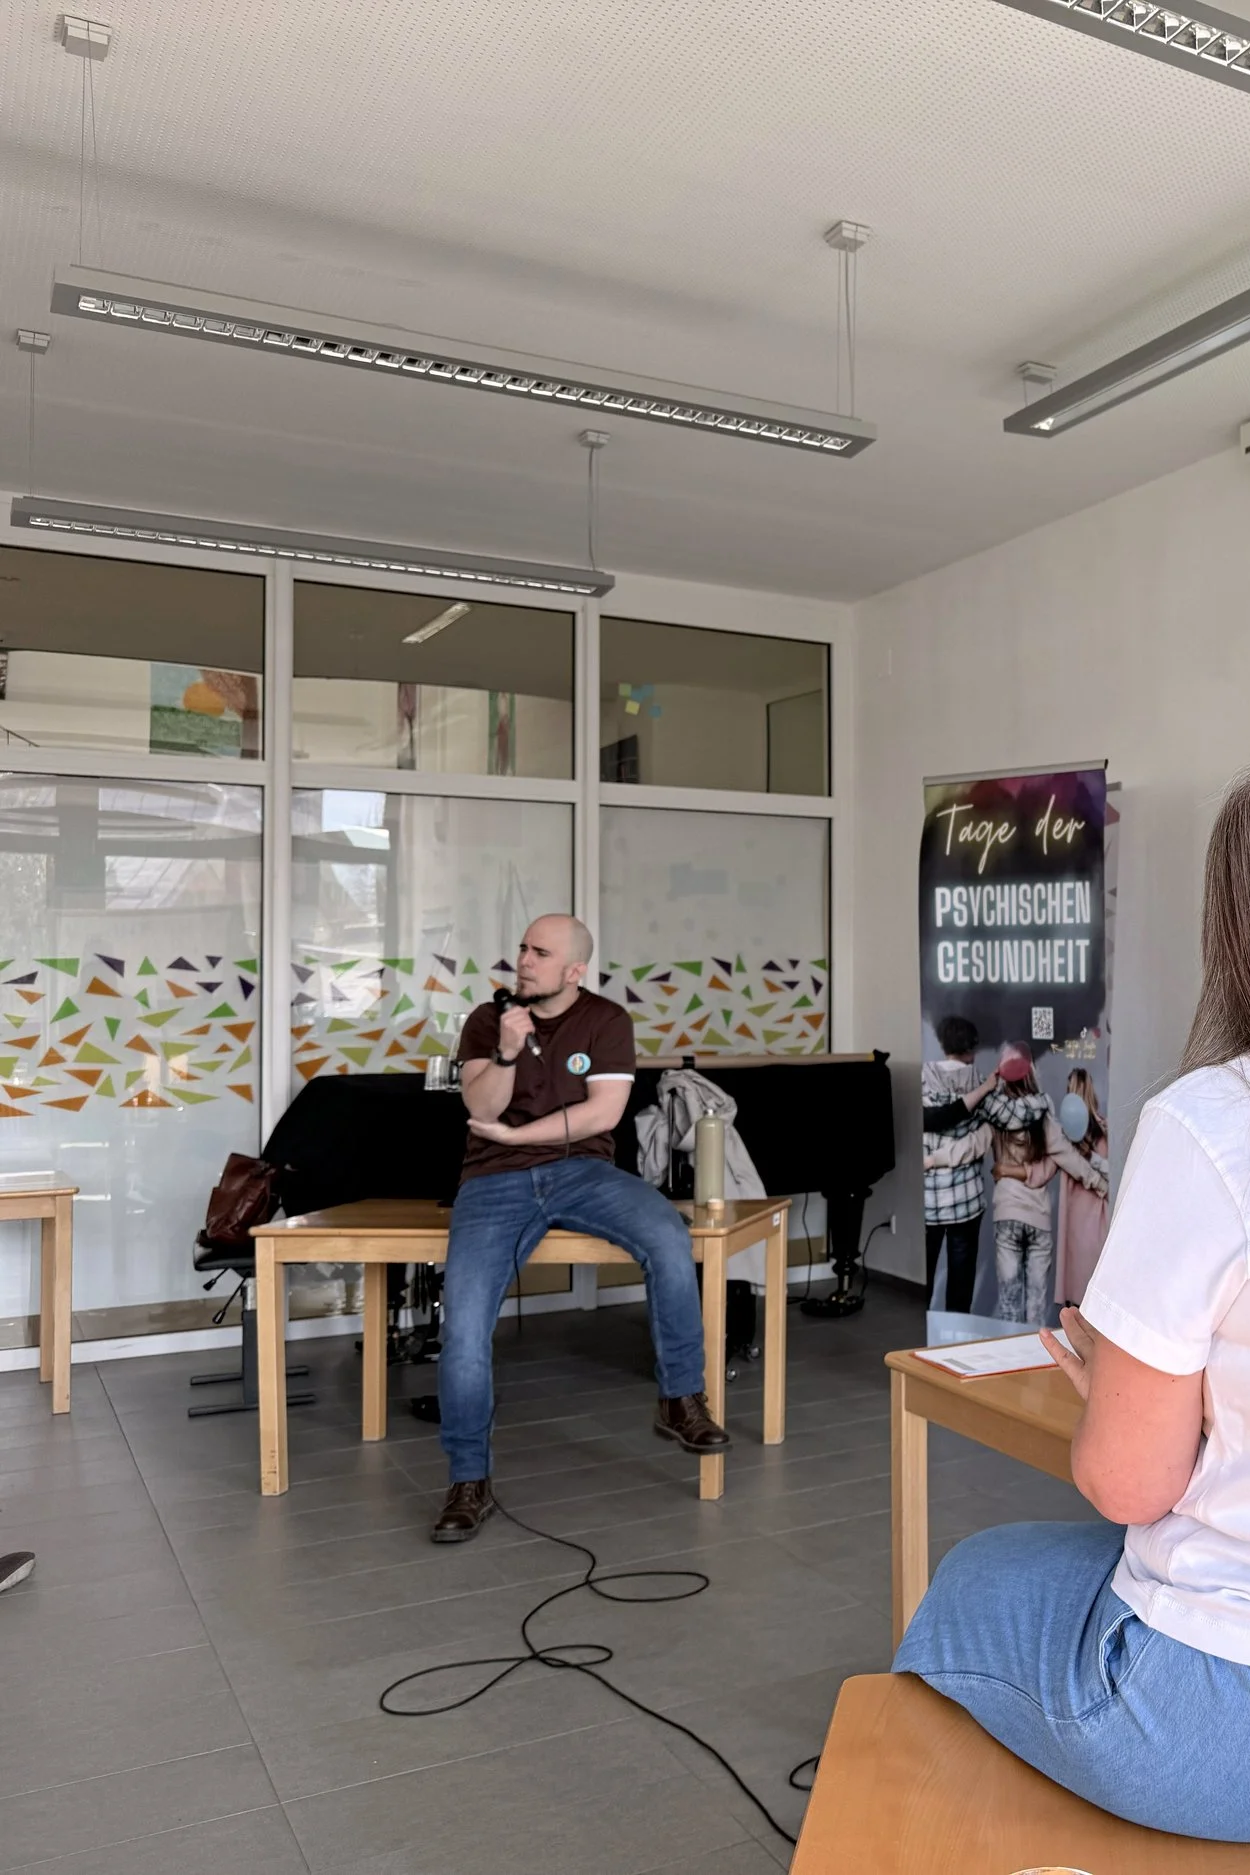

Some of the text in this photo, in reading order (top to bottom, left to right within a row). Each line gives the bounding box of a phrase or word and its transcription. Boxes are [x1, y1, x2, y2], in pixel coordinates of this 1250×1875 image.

[935, 793, 1086, 875] Tage der
[934, 880, 1092, 928] PSYCHISCHEN
[936, 939, 1091, 984] GESUNDHEIT
